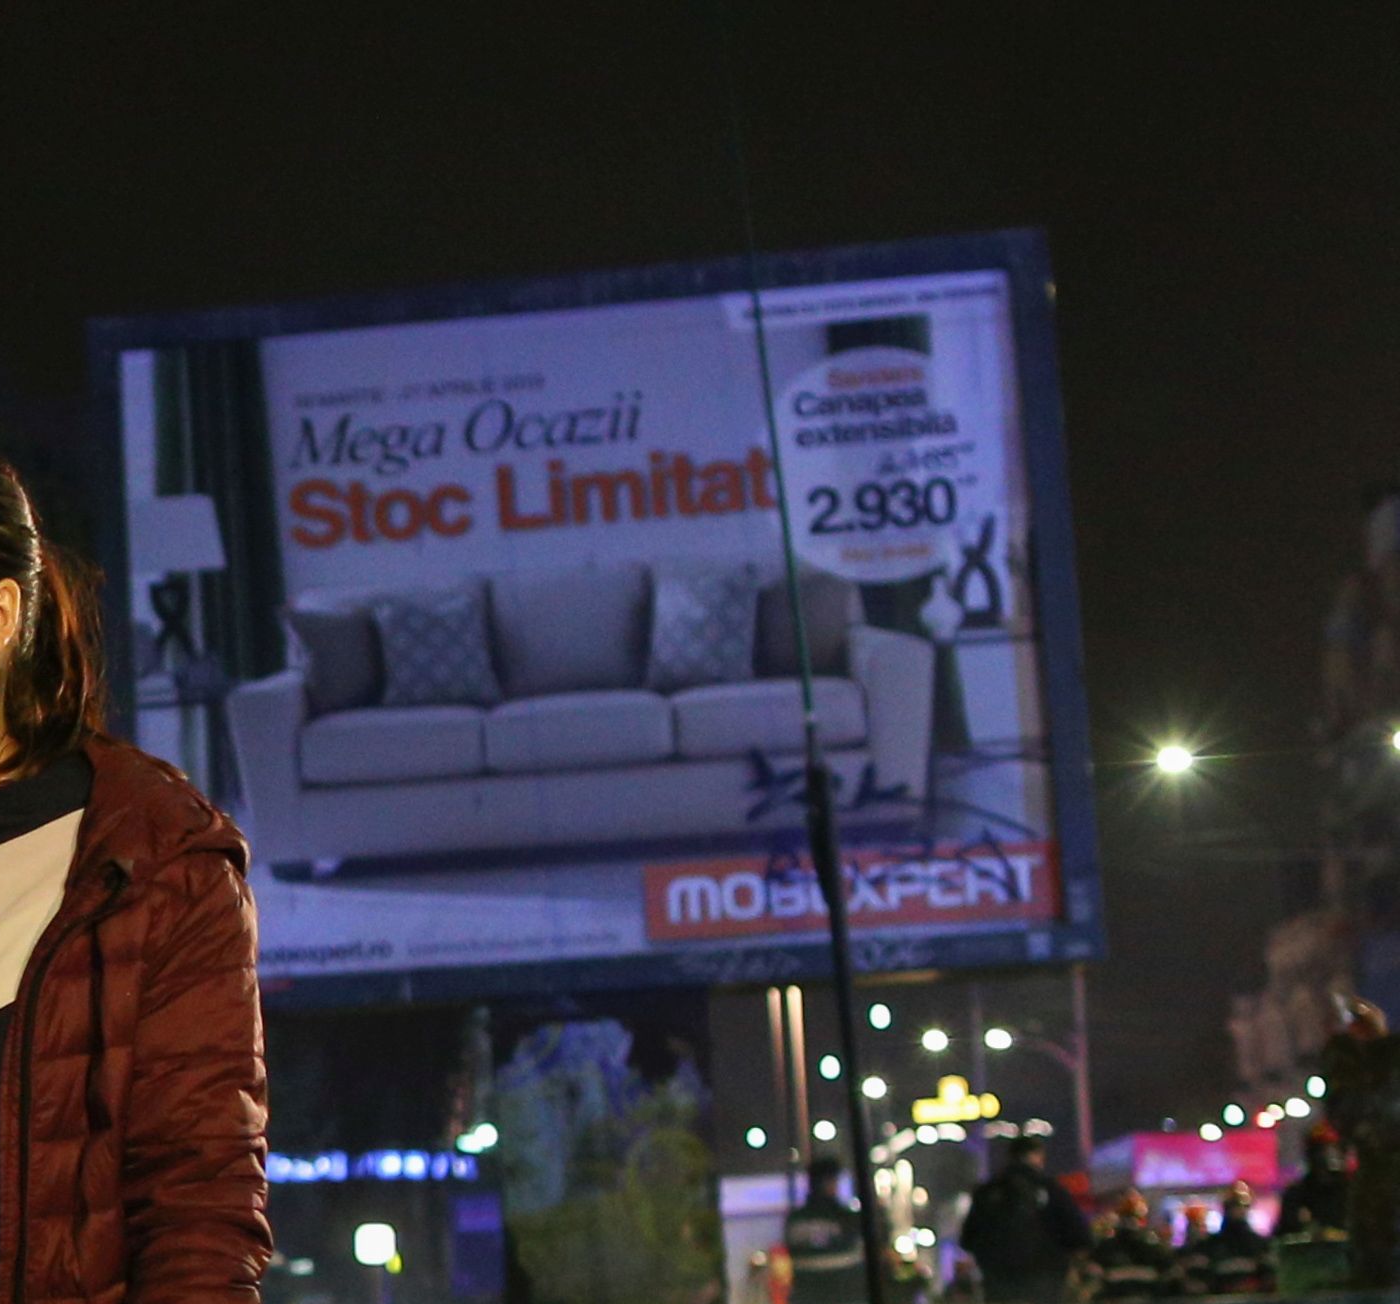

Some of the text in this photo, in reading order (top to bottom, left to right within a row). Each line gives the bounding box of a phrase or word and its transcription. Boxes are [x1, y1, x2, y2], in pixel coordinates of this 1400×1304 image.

[289, 390, 643, 476] Mega Ocazii
[793, 386, 929, 418] Canapea
[288, 446, 778, 549] Stoc Limitat
[807, 475, 957, 535] 2.930
